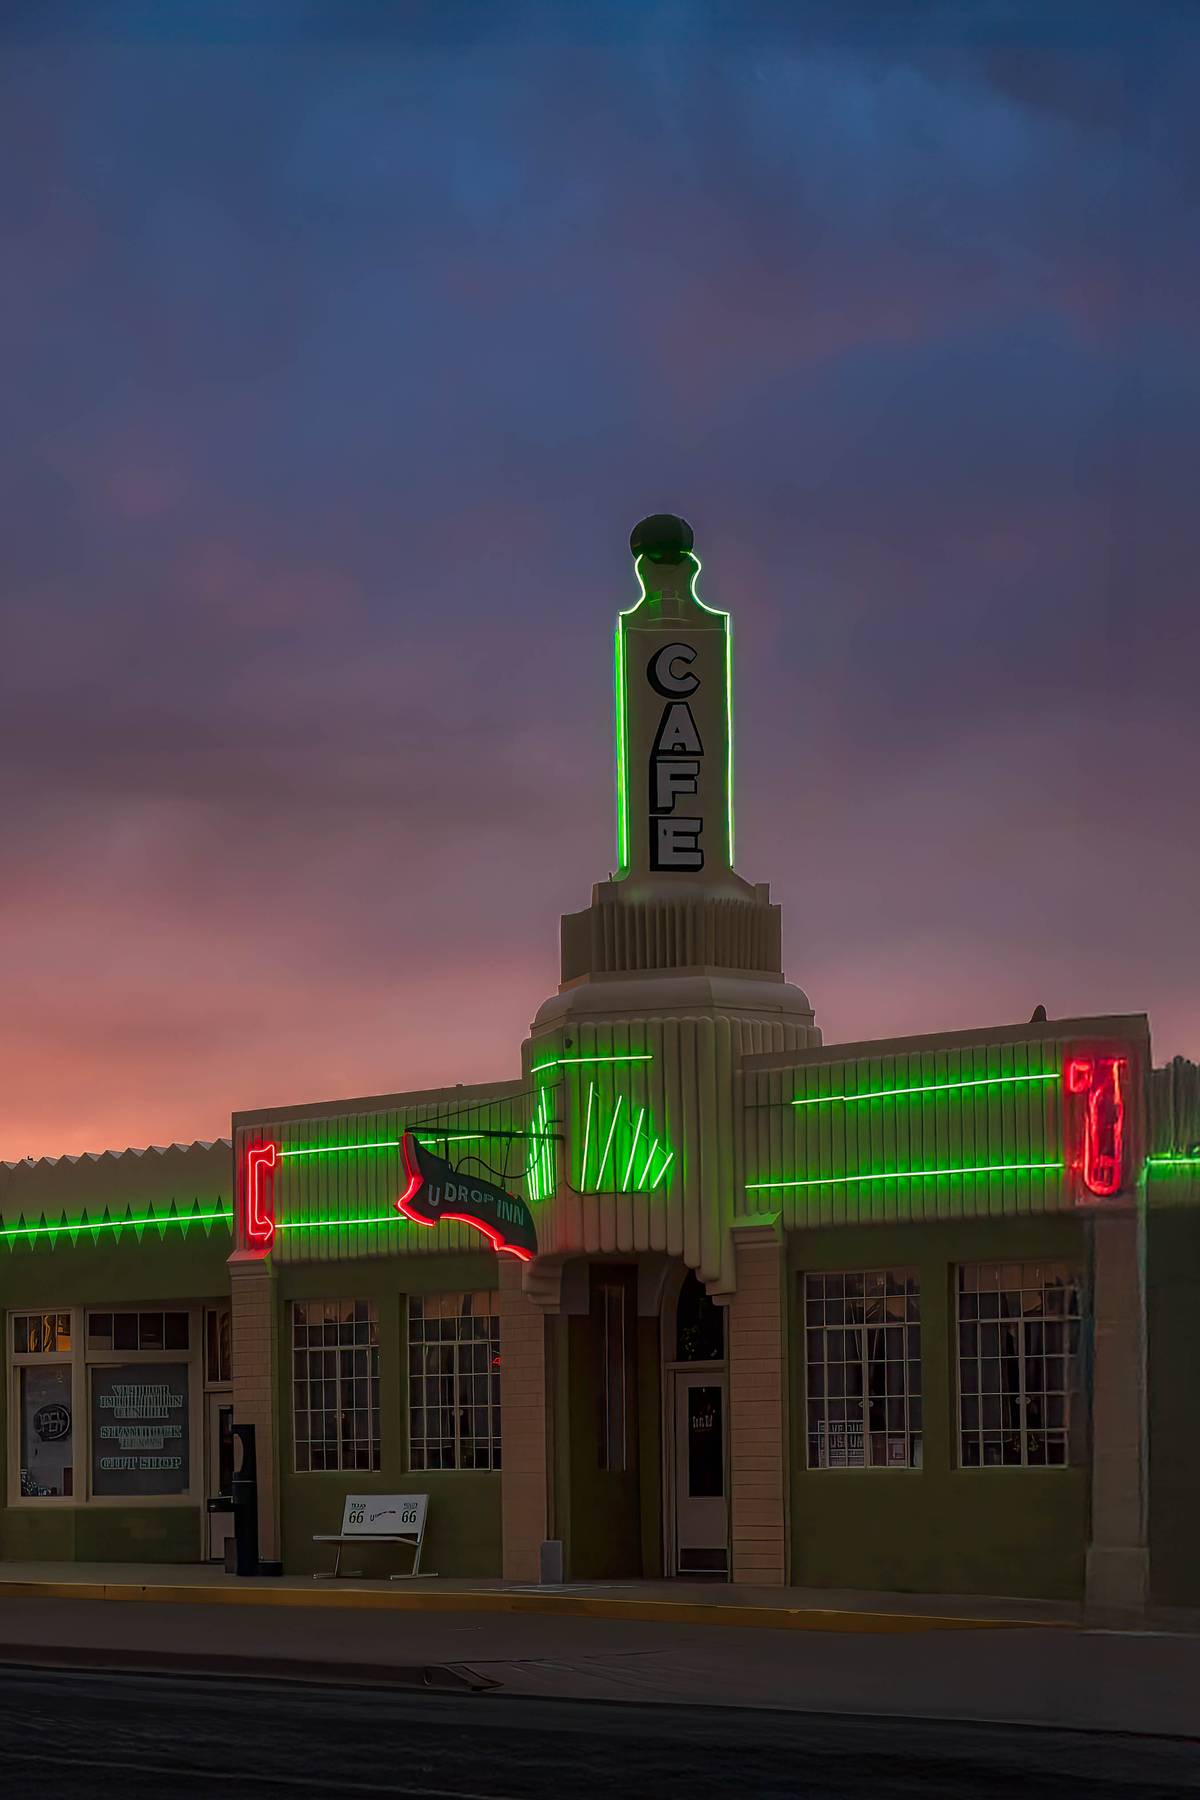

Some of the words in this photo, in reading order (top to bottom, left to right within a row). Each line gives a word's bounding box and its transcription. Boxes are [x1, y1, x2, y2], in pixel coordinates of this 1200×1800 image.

[647, 643, 704, 872] CAFE
[428, 1184, 441, 1207] U
[444, 1182, 494, 1204] DROP
[496, 1199, 524, 1226] INN
[349, 1510, 364, 1523] 66
[401, 1510, 417, 1523] 66
